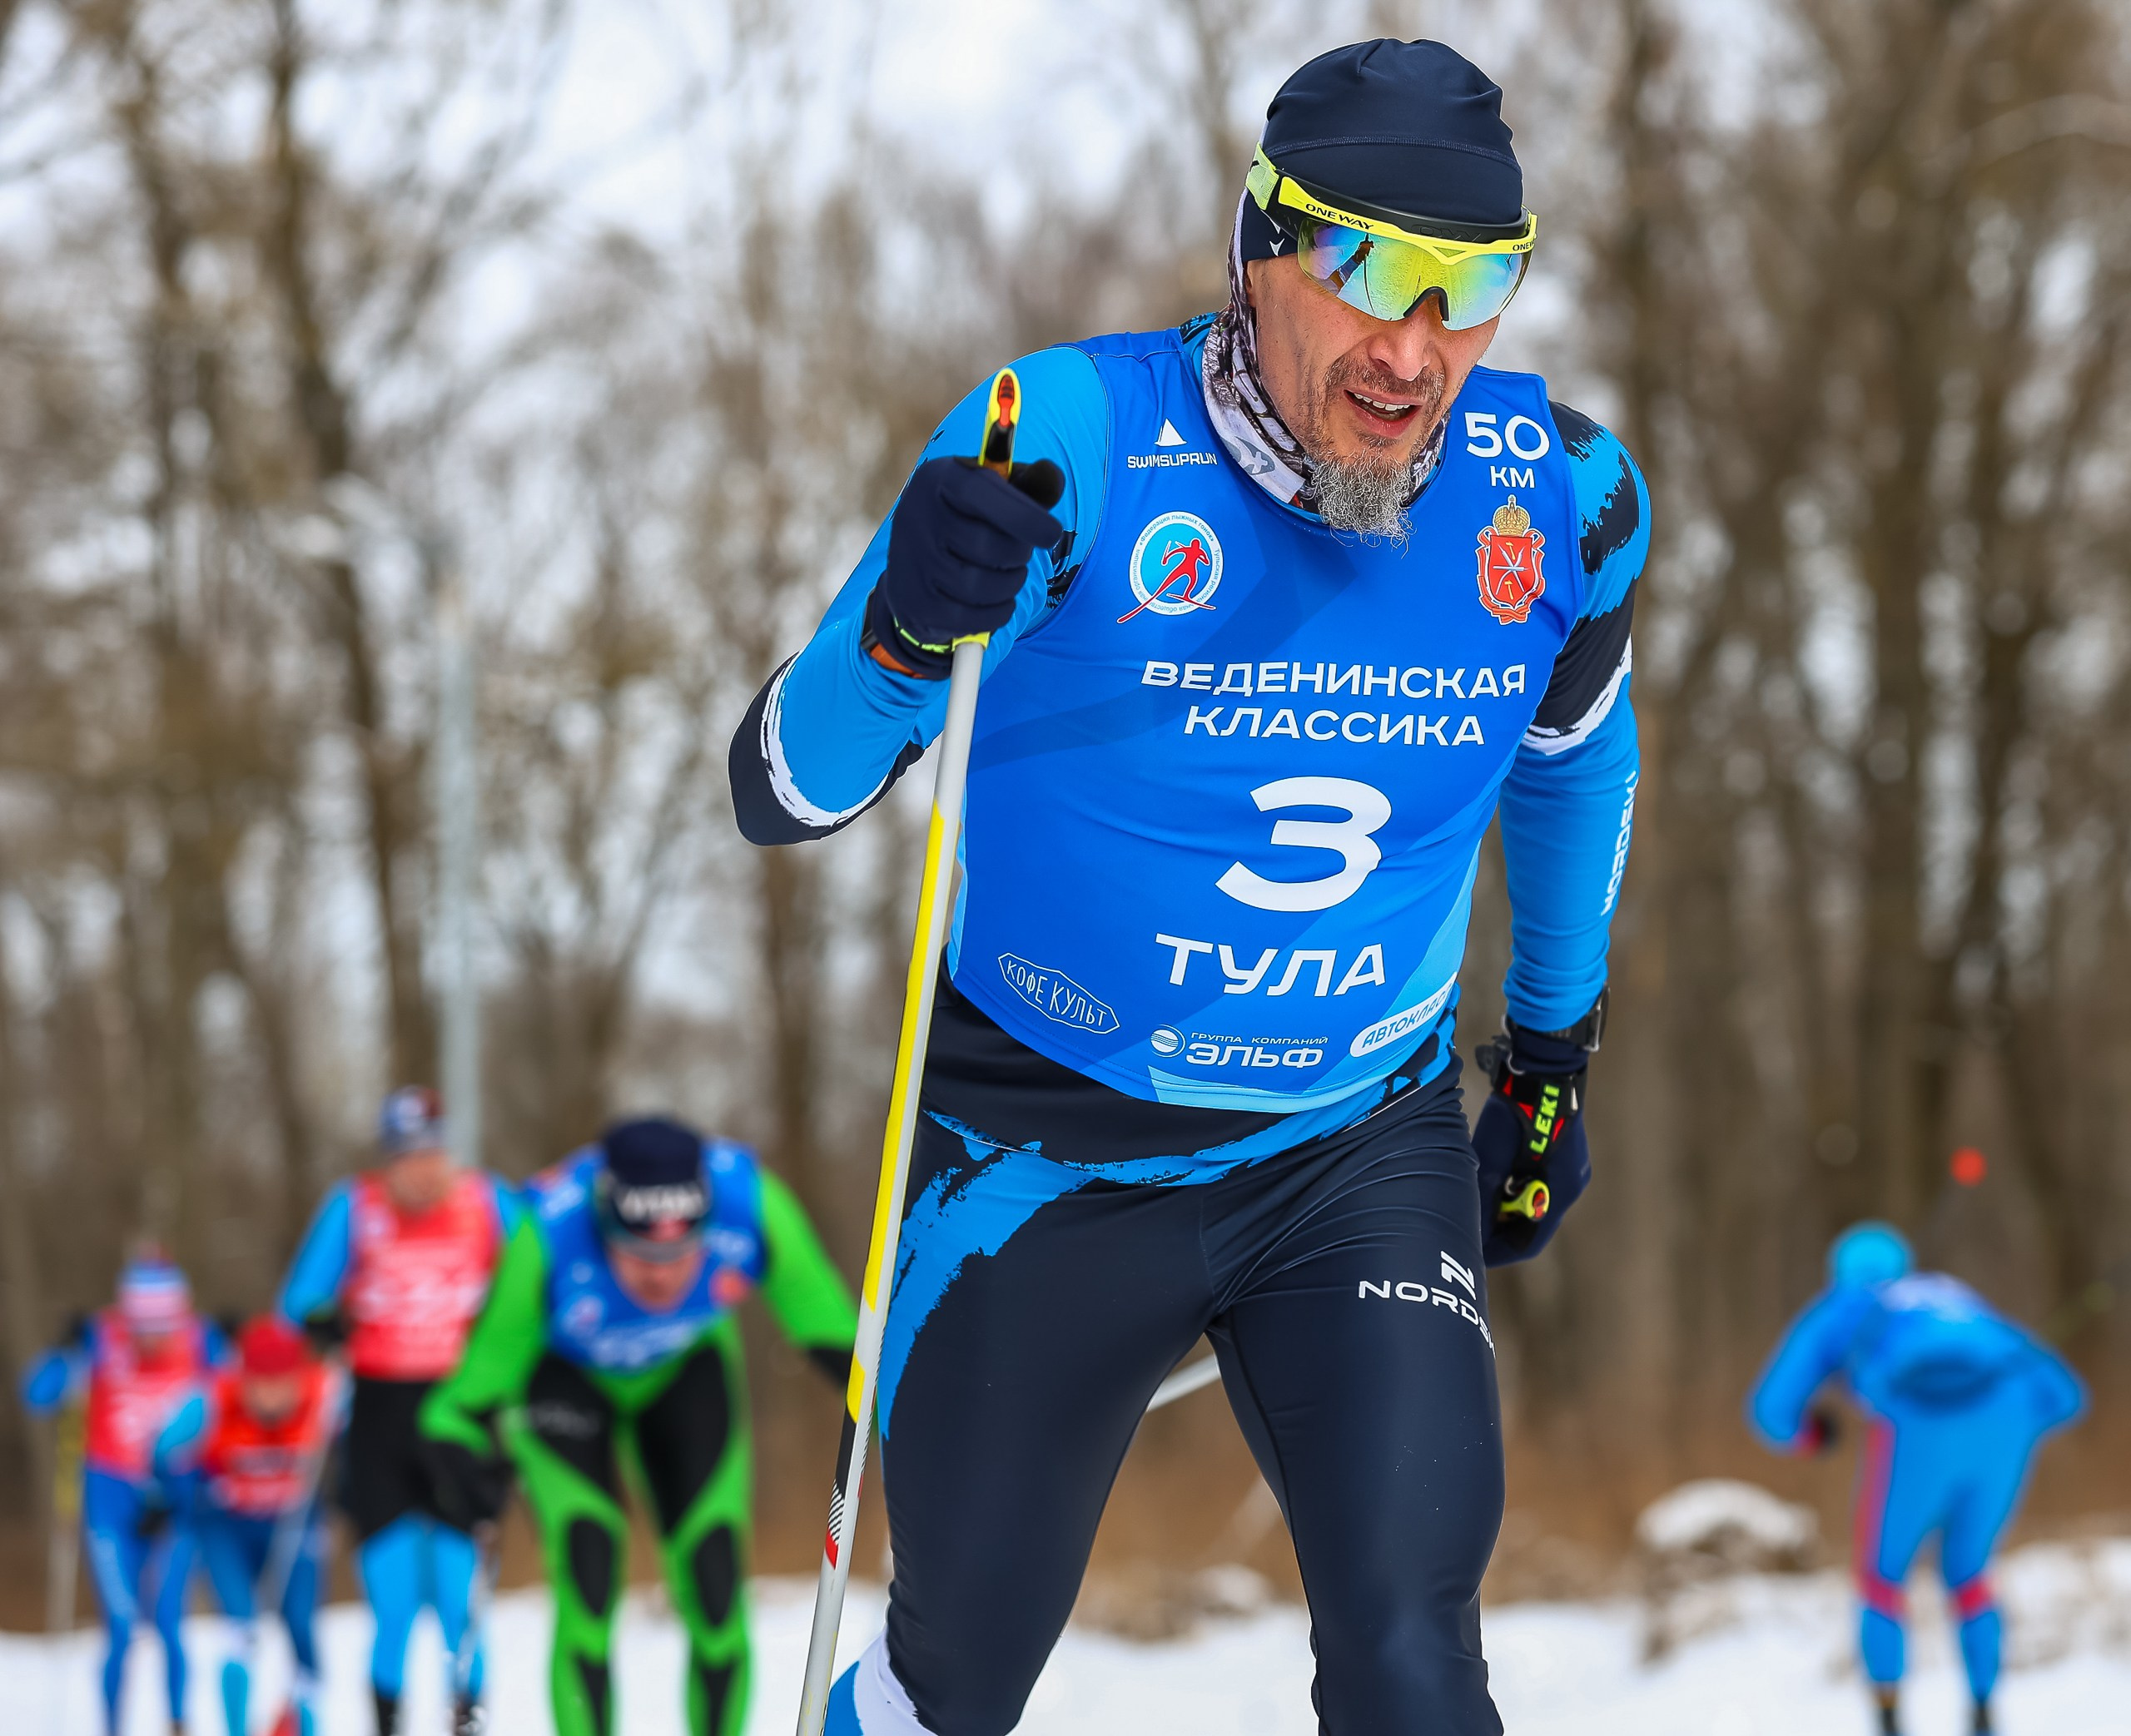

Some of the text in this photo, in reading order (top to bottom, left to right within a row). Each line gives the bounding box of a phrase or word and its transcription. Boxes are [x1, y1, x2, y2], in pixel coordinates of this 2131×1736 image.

[1305, 203, 1374, 231] ONE WAY
[1464, 412, 1550, 461] 50
[1127, 452, 1218, 469] SWIMSUPRUN
[1490, 465, 1535, 489] КМ
[1140, 660, 1526, 699] ВЕДЕНИНСКАЯ
[1183, 705, 1486, 746] КЛАССИКА
[1215, 776, 1393, 912] 3
[1155, 932, 1386, 997] ТУЛА
[1006, 960, 1107, 1027] КОФЕ КУЛЬТ
[1185, 1042, 1324, 1069] ЭЛЬФ
[1191, 1032, 1329, 1045] ГРУППА КОМПАНИЙ
[1529, 1084, 1560, 1154] LEKI
